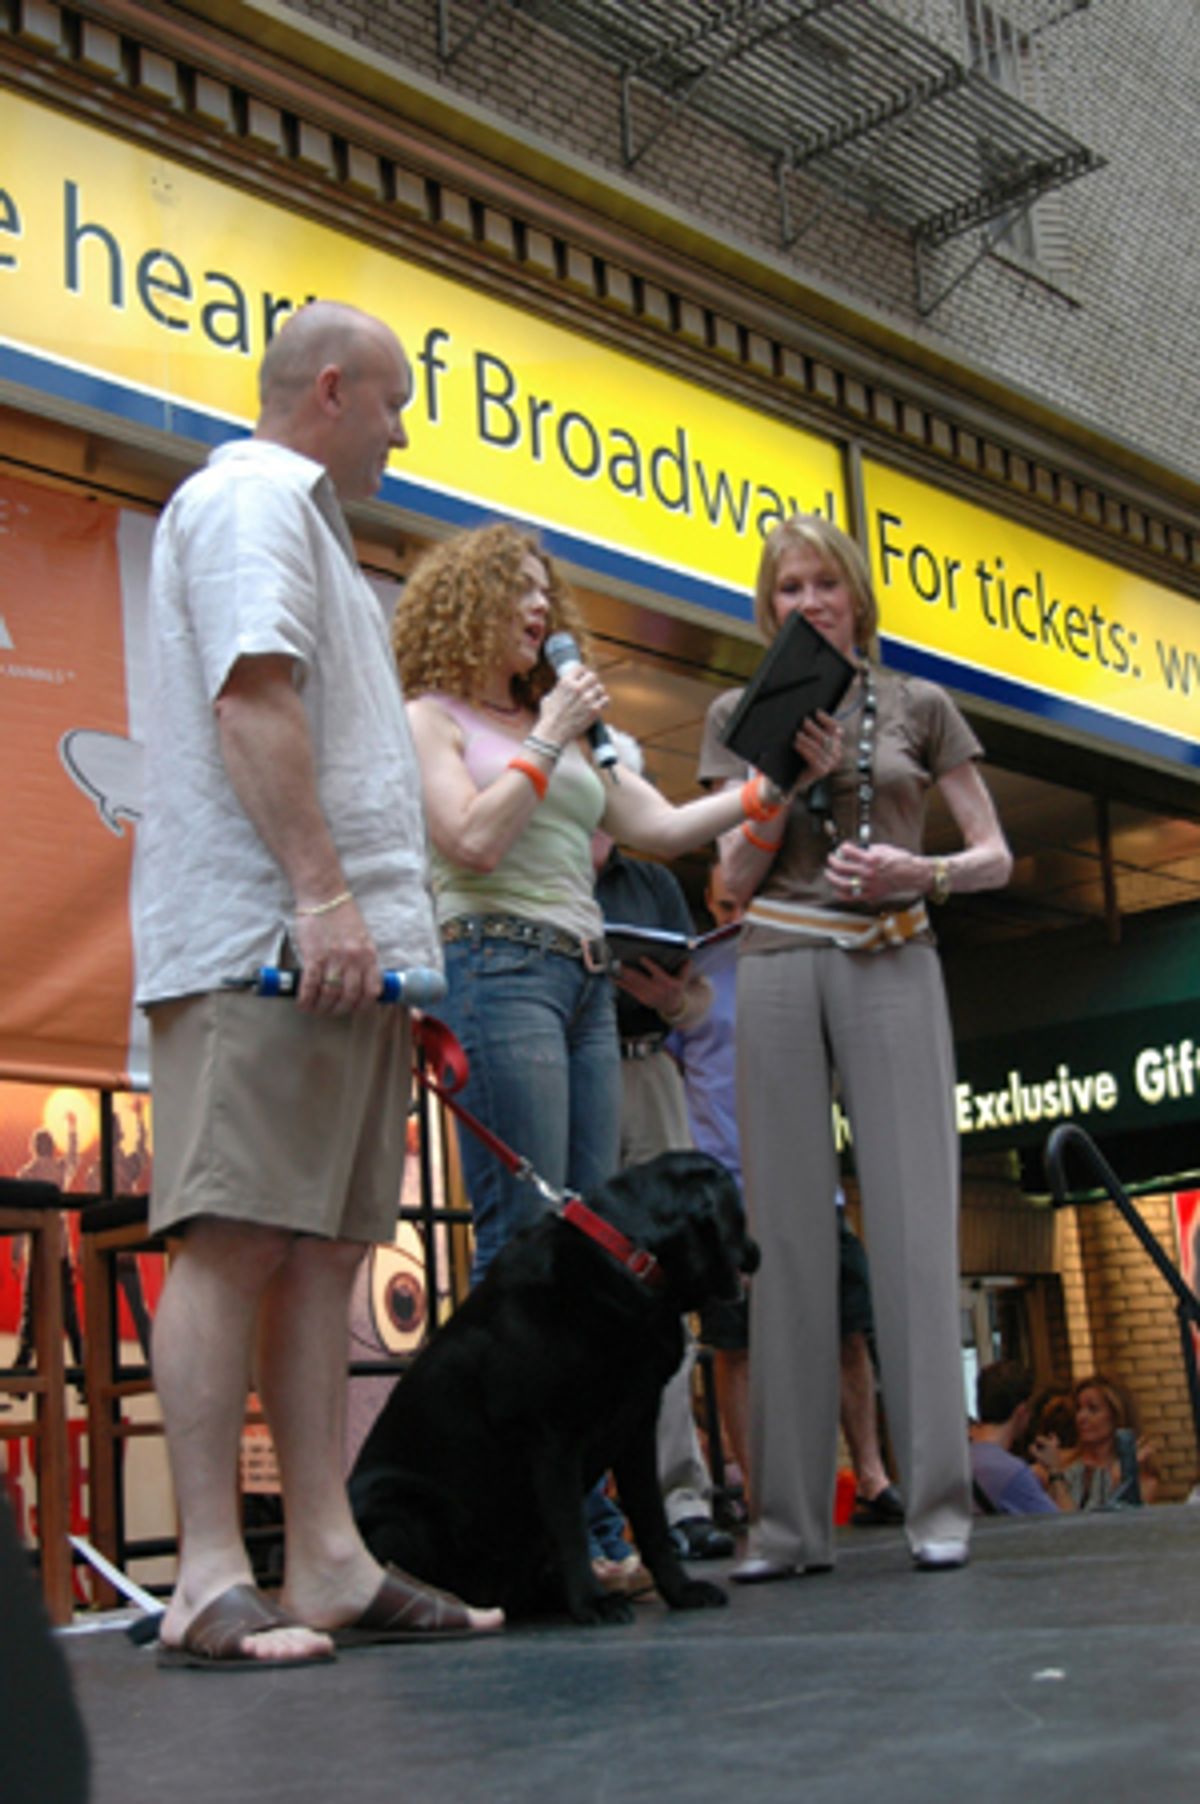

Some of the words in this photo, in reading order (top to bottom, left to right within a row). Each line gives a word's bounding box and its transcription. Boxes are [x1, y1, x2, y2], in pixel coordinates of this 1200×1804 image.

[64, 179, 316, 353] hear
[396, 328, 449, 421] f
[475, 350, 833, 539] Broadwa
[877, 510, 960, 609] For
[976, 556, 1140, 678] tickets:
[955, 1064, 1118, 1133] Exclusive
